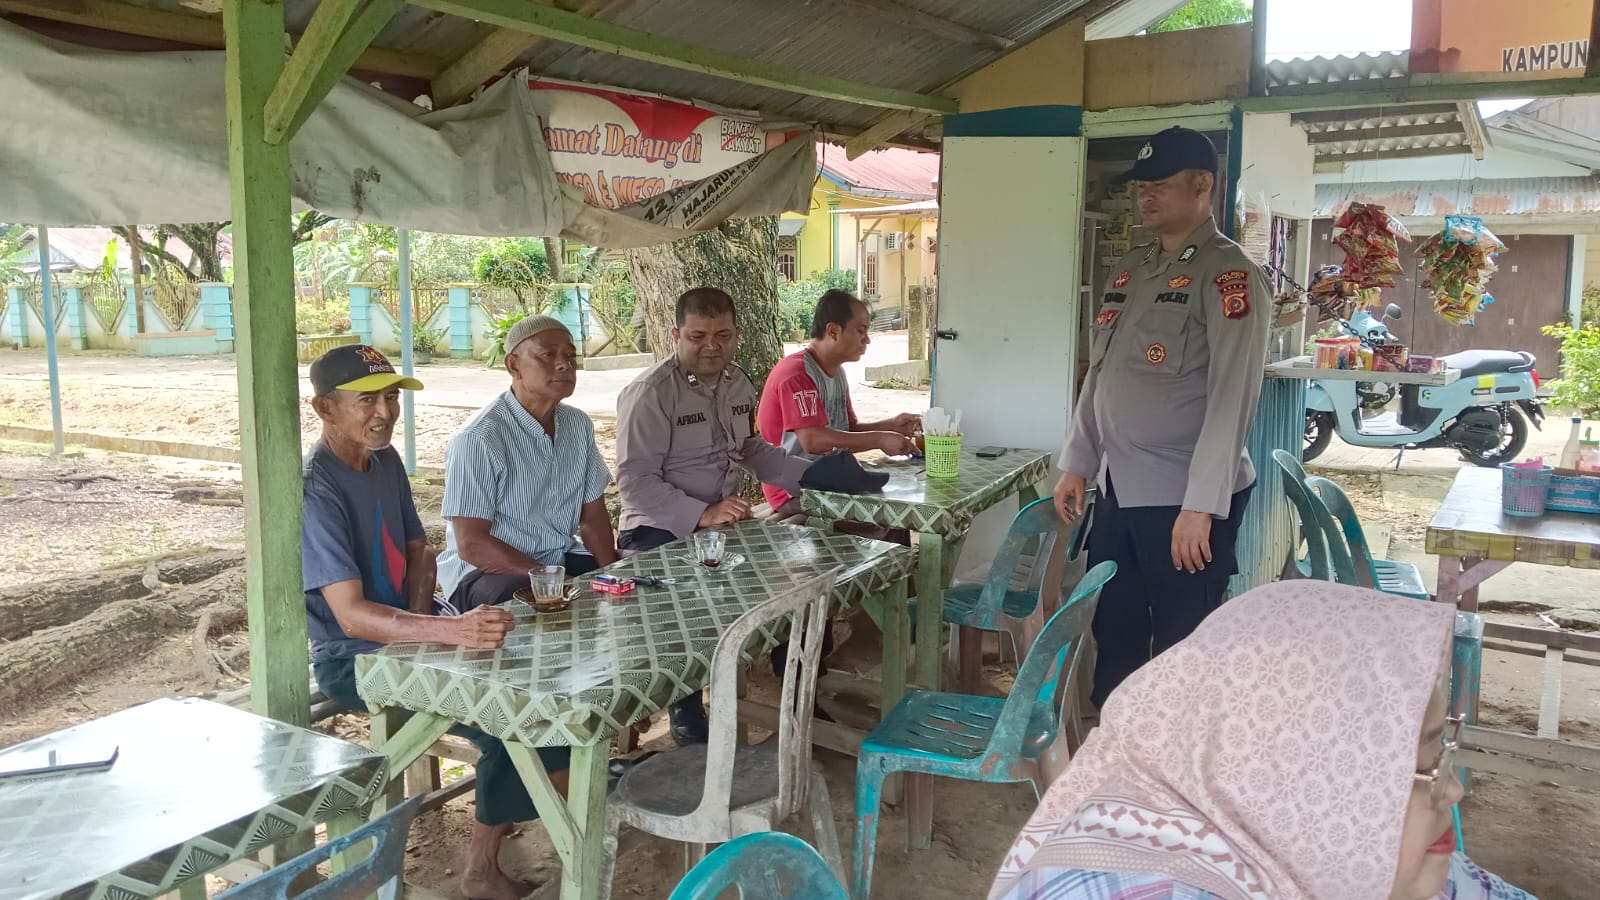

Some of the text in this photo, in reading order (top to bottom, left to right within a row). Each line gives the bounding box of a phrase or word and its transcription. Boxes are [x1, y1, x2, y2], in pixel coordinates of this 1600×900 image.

[602, 123, 683, 168] Datang
[682, 132, 703, 164] di
[1154, 291, 1190, 304] POLRI
[793, 389, 818, 417] 17
[676, 412, 707, 427] AFRIZAL
